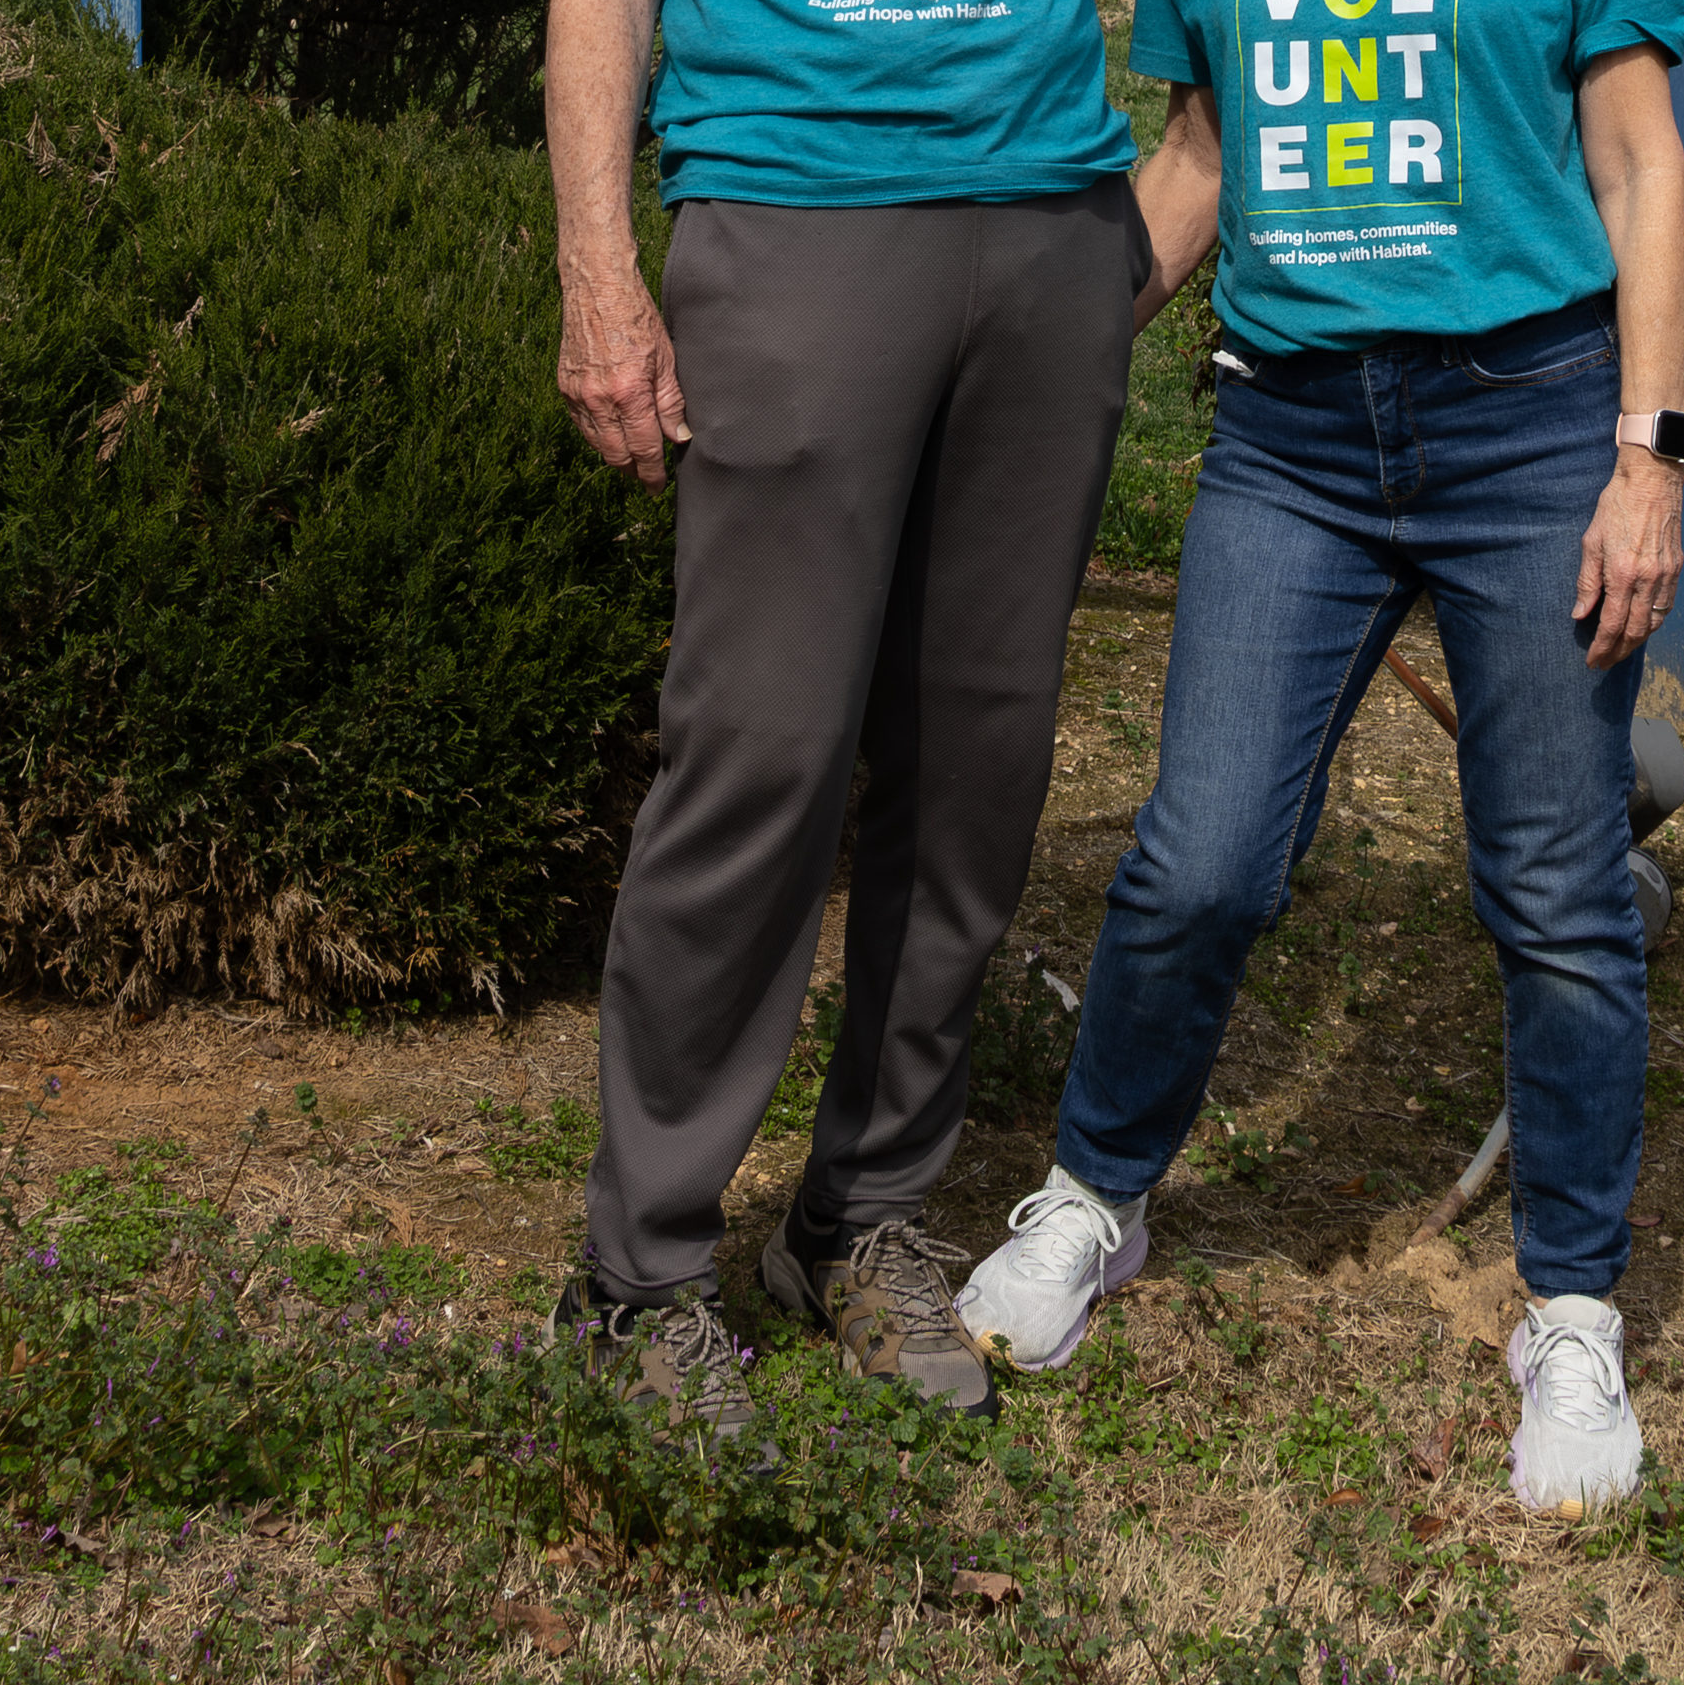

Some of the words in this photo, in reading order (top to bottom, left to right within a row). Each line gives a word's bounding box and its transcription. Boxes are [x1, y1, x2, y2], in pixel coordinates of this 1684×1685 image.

[833, 8, 867, 22] and
[869, 7, 914, 24] hope
[915, 5, 954, 20] with
[1254, 34, 1437, 106] UNT
[1259, 120, 1443, 191] EER
[1249, 230, 1303, 246] Building
[1305, 229, 1359, 243] homes,
[1360, 221, 1458, 239] communities
[1269, 250, 1296, 265] and
[1298, 249, 1337, 266] hope
[1339, 246, 1371, 262] with
[1372, 242, 1433, 259] Habitat.
